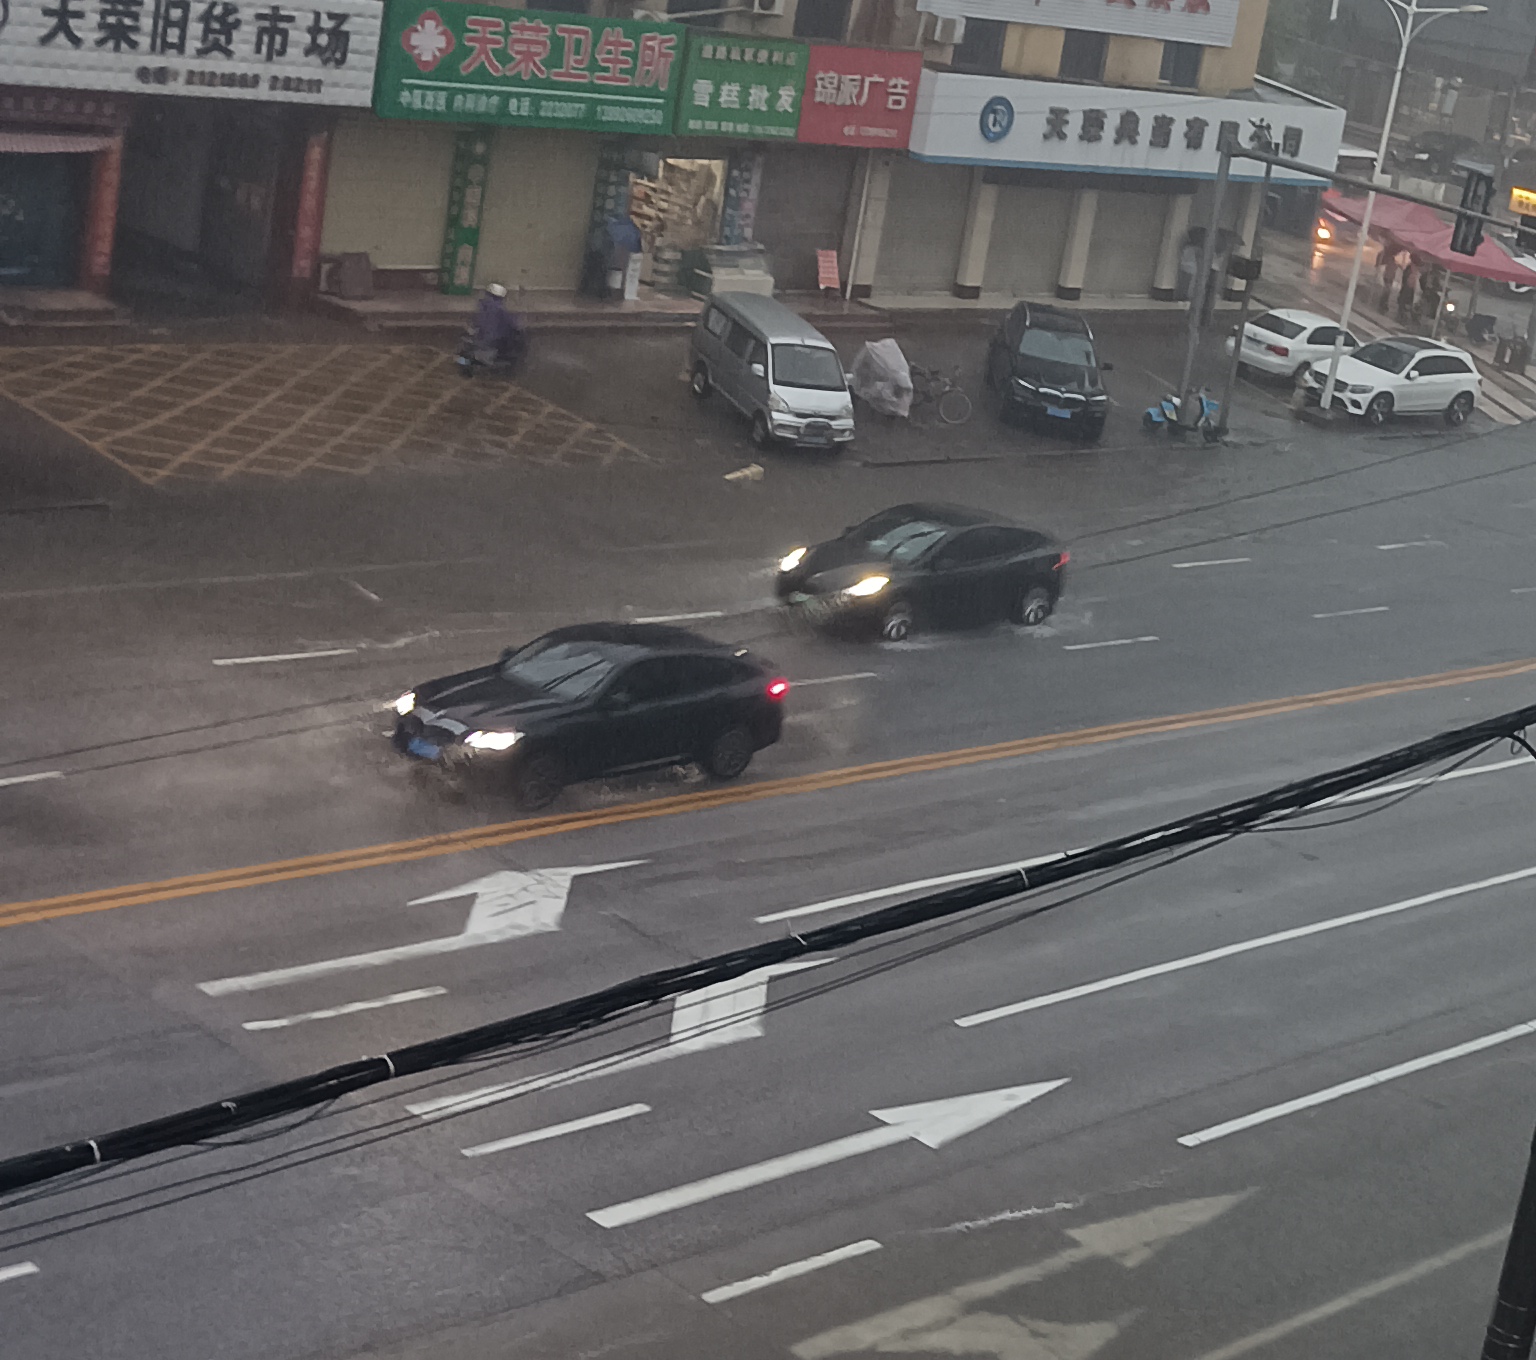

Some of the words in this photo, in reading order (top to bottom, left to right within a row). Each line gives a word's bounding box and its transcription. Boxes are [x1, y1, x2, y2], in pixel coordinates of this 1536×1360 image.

[460, 15, 678, 92] 天荣卫生所
[691, 78, 797, 114] 雪糕批发
